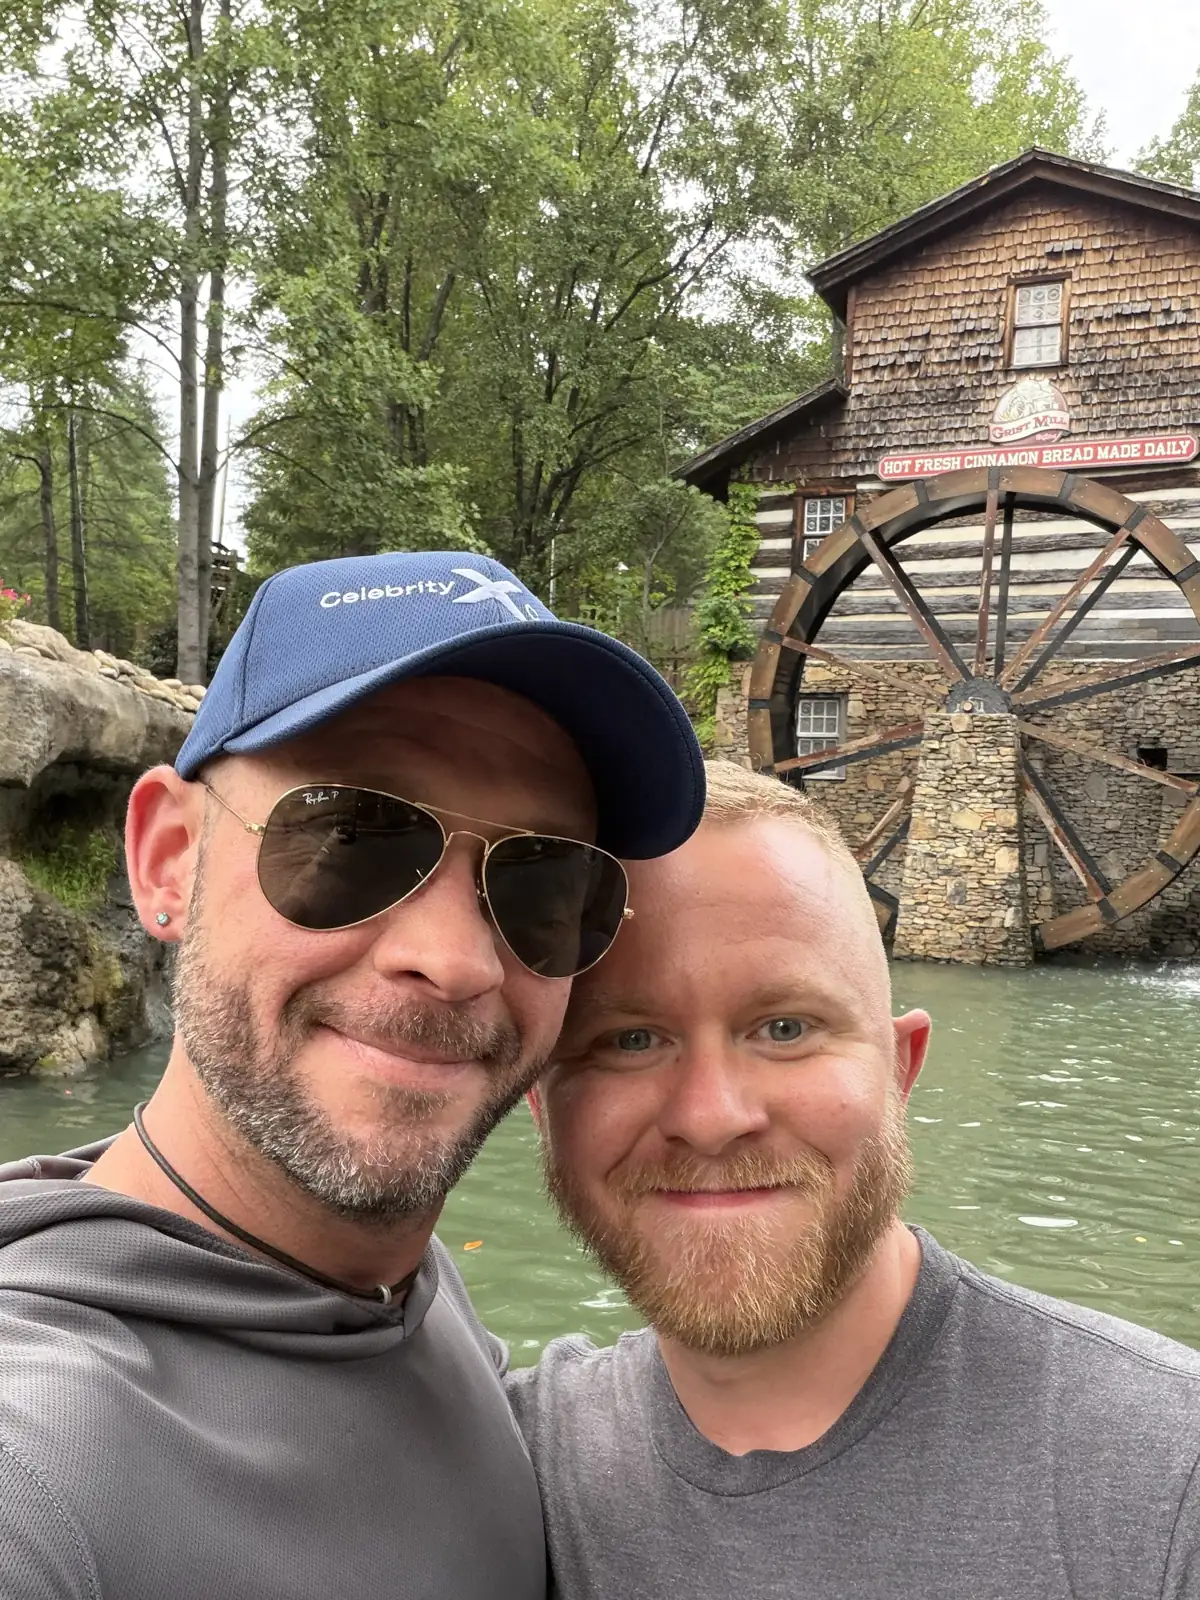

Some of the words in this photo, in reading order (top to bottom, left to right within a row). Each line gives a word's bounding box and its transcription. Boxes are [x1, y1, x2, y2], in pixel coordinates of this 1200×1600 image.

[883, 459, 912, 474] HOT
[914, 456, 962, 472] FRESH
[964, 451, 1039, 469] CINNAMON
[1042, 447, 1094, 464] BREAD
[1097, 443, 1141, 460] MADE
[1144, 440, 1191, 457] DAILY
[319, 580, 456, 609] Celebrity
